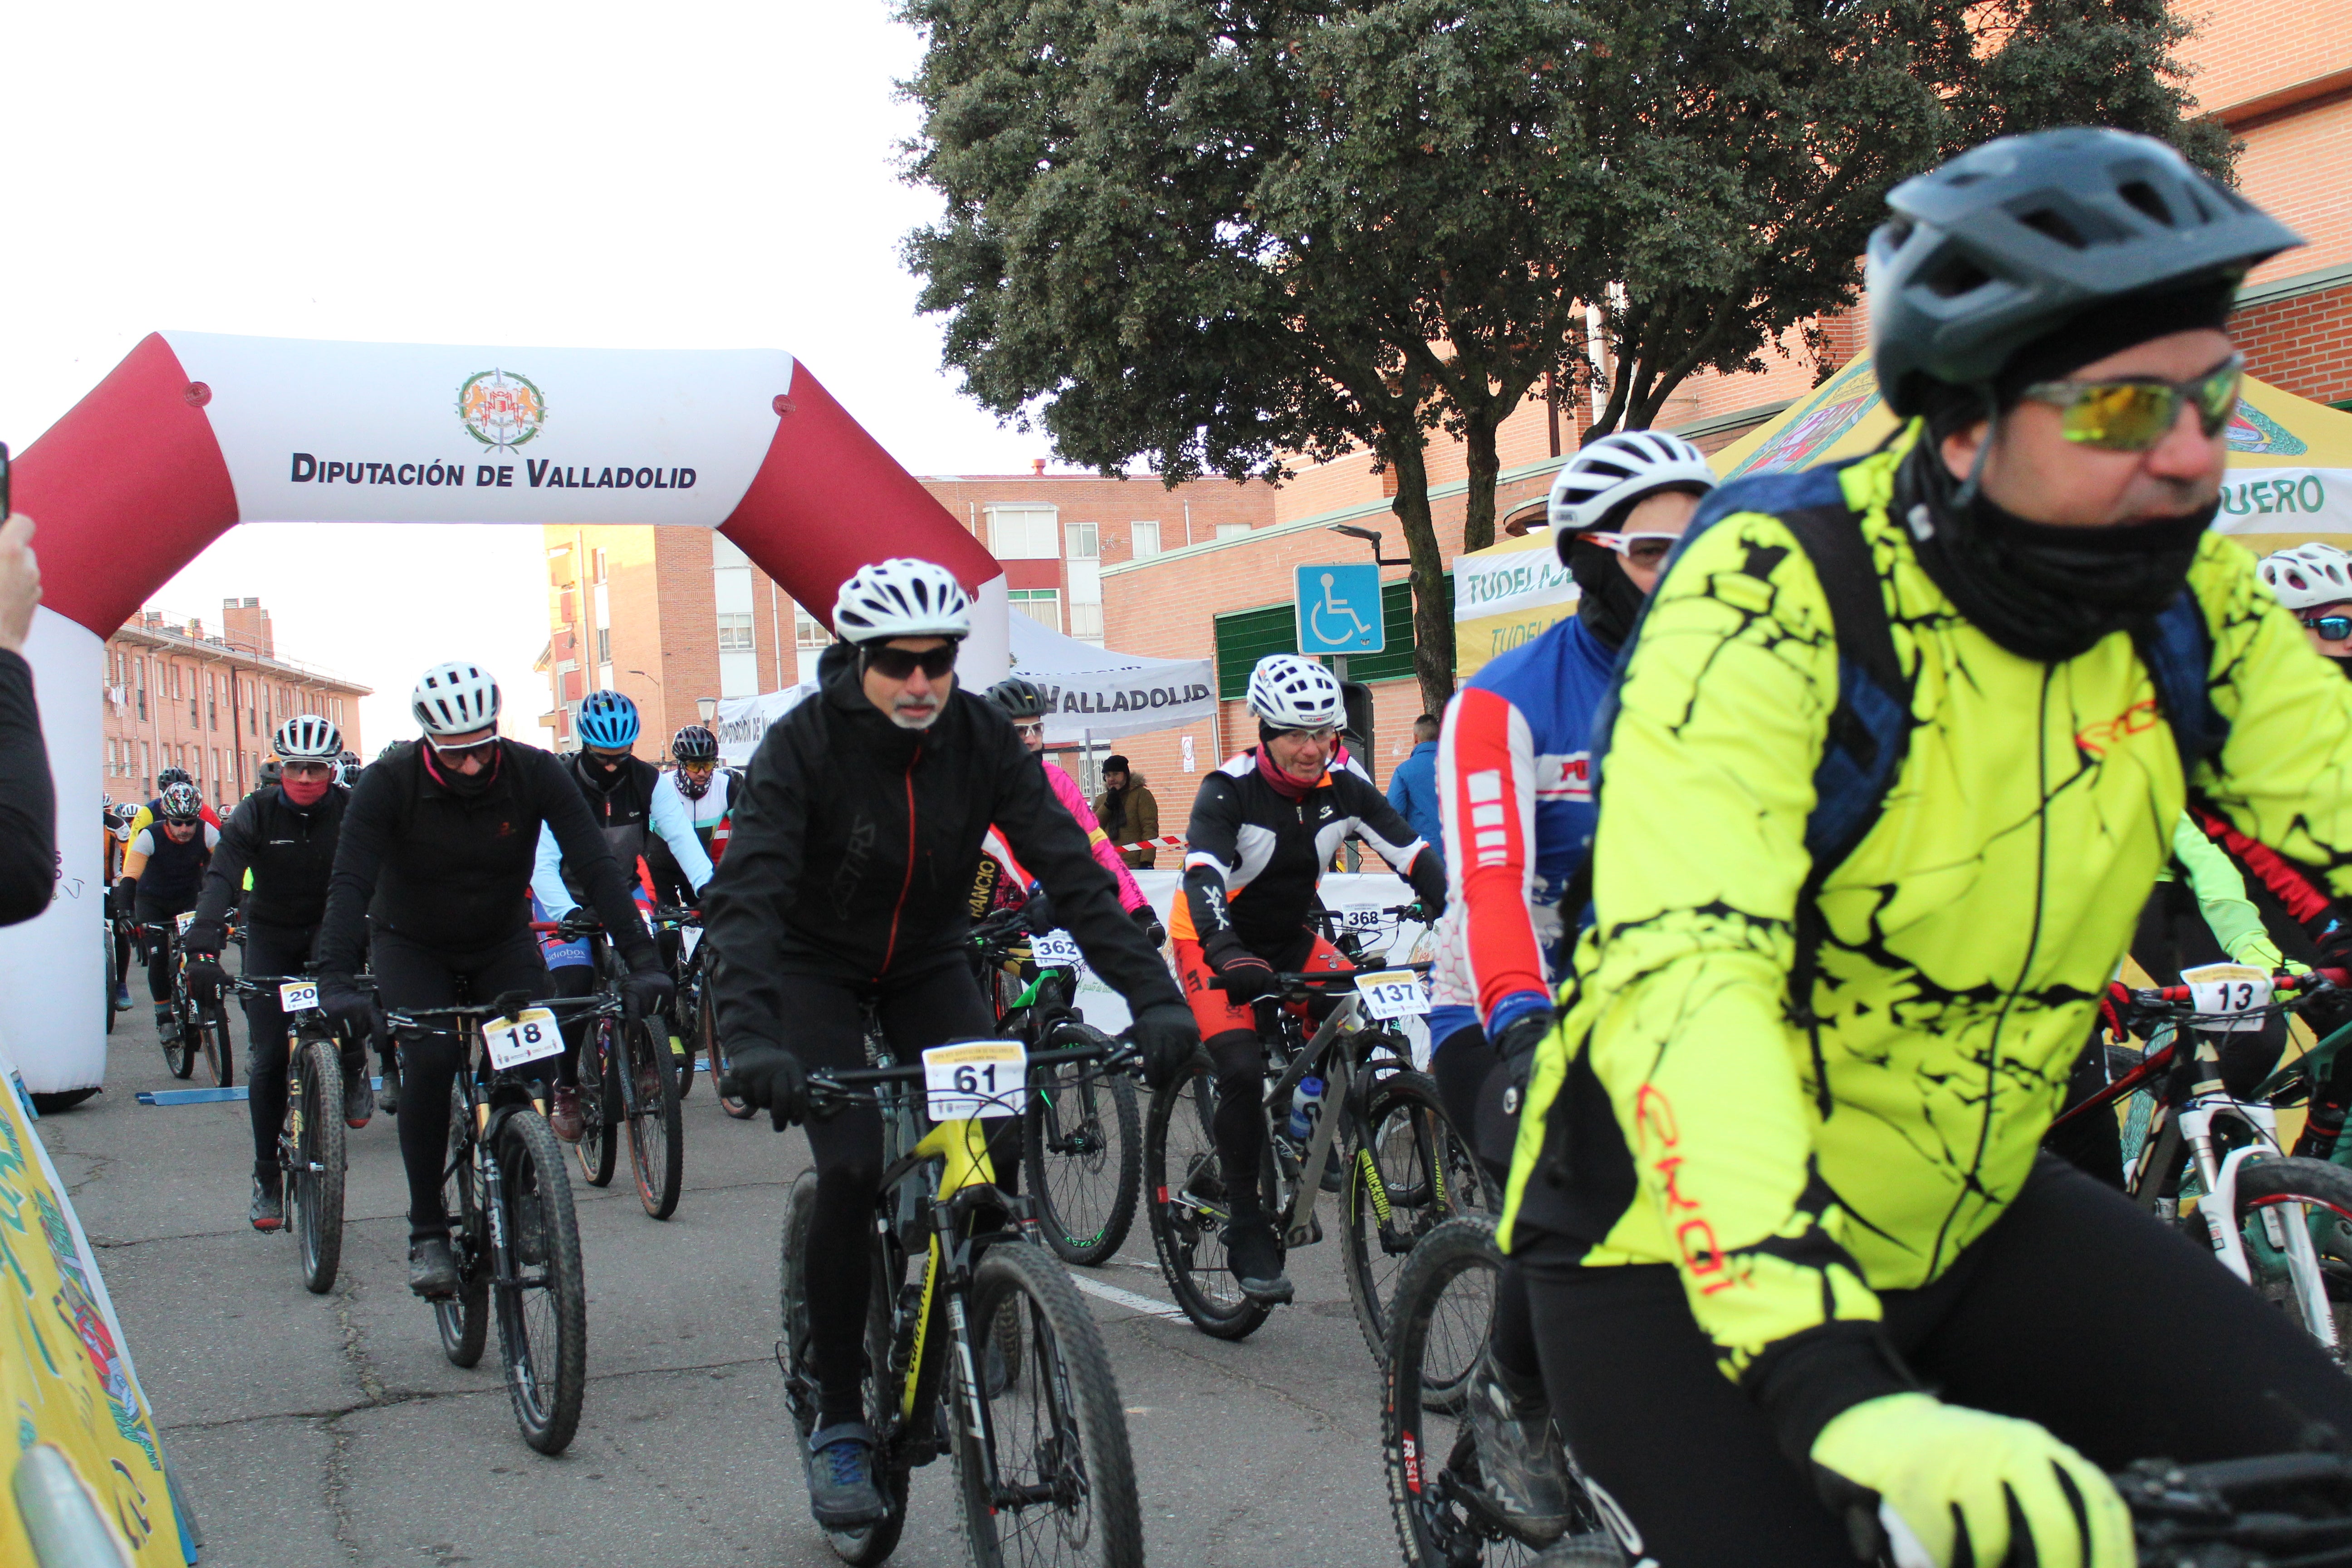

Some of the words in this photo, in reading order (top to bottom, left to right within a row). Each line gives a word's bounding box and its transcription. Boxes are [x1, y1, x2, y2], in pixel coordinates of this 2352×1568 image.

[290, 452, 465, 486] DIPUTACIÓN
[476, 464, 513, 487] DE
[526, 459, 697, 489] VALLADOLID
[2222, 475, 2324, 515] UERO
[1468, 564, 1550, 604] TUDELA
[1038, 682, 1210, 714] VALLADOLID
[753, 717, 760, 741] DE
[1349, 911, 1378, 926] 368
[1039, 940, 1077, 956] 362
[289, 988, 315, 1003] 20
[1372, 984, 1414, 1004] 137
[2218, 983, 2253, 1011] 13
[506, 1023, 542, 1048] 18
[954, 1064, 995, 1094] 61
